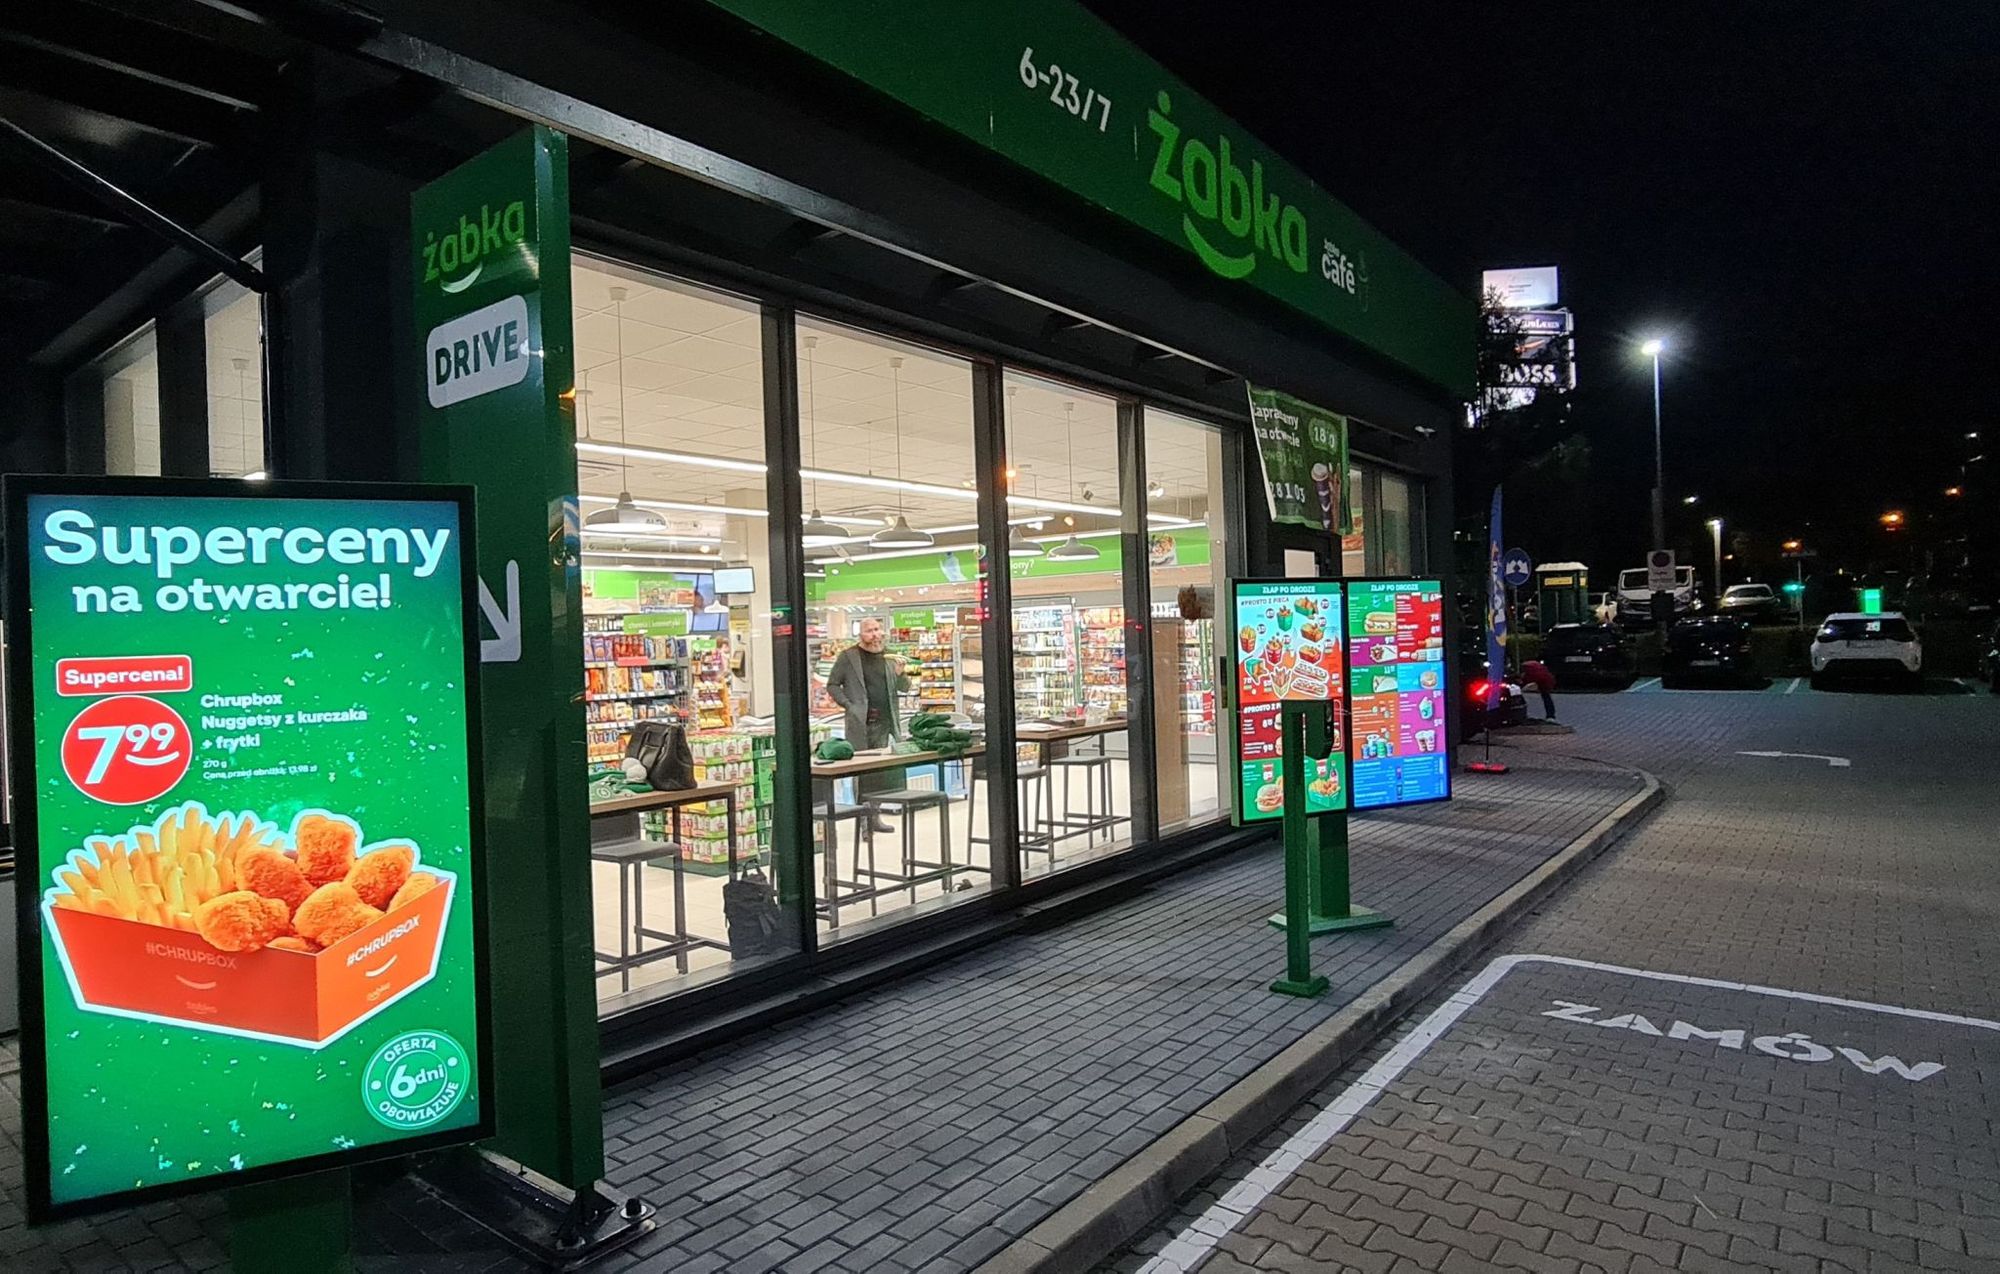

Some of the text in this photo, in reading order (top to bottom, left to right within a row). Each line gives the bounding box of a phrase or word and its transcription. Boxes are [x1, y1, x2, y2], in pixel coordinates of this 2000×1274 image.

[1019, 46, 1111, 133] 6-23/7
[1149, 90, 1308, 273] żabka
[423, 201, 525, 284] żabka
[1321, 254, 1356, 295] café
[435, 320, 518, 386] DRIVE
[44, 509, 450, 578] Superceny
[73, 573, 392, 613] na otwarcie!
[64, 666, 184, 686] Supercena!
[200, 693, 283, 708] Chrupbox
[201, 708, 368, 730] Nuggetsy z kurczaka
[216, 733, 260, 754] frytki
[145, 942, 237, 970] #CHRUPBOX
[346, 914, 421, 967] #CHRUPBOX
[383, 1037, 438, 1063] OFERTA
[378, 1080, 460, 1122] OBOWIĄZUJE
